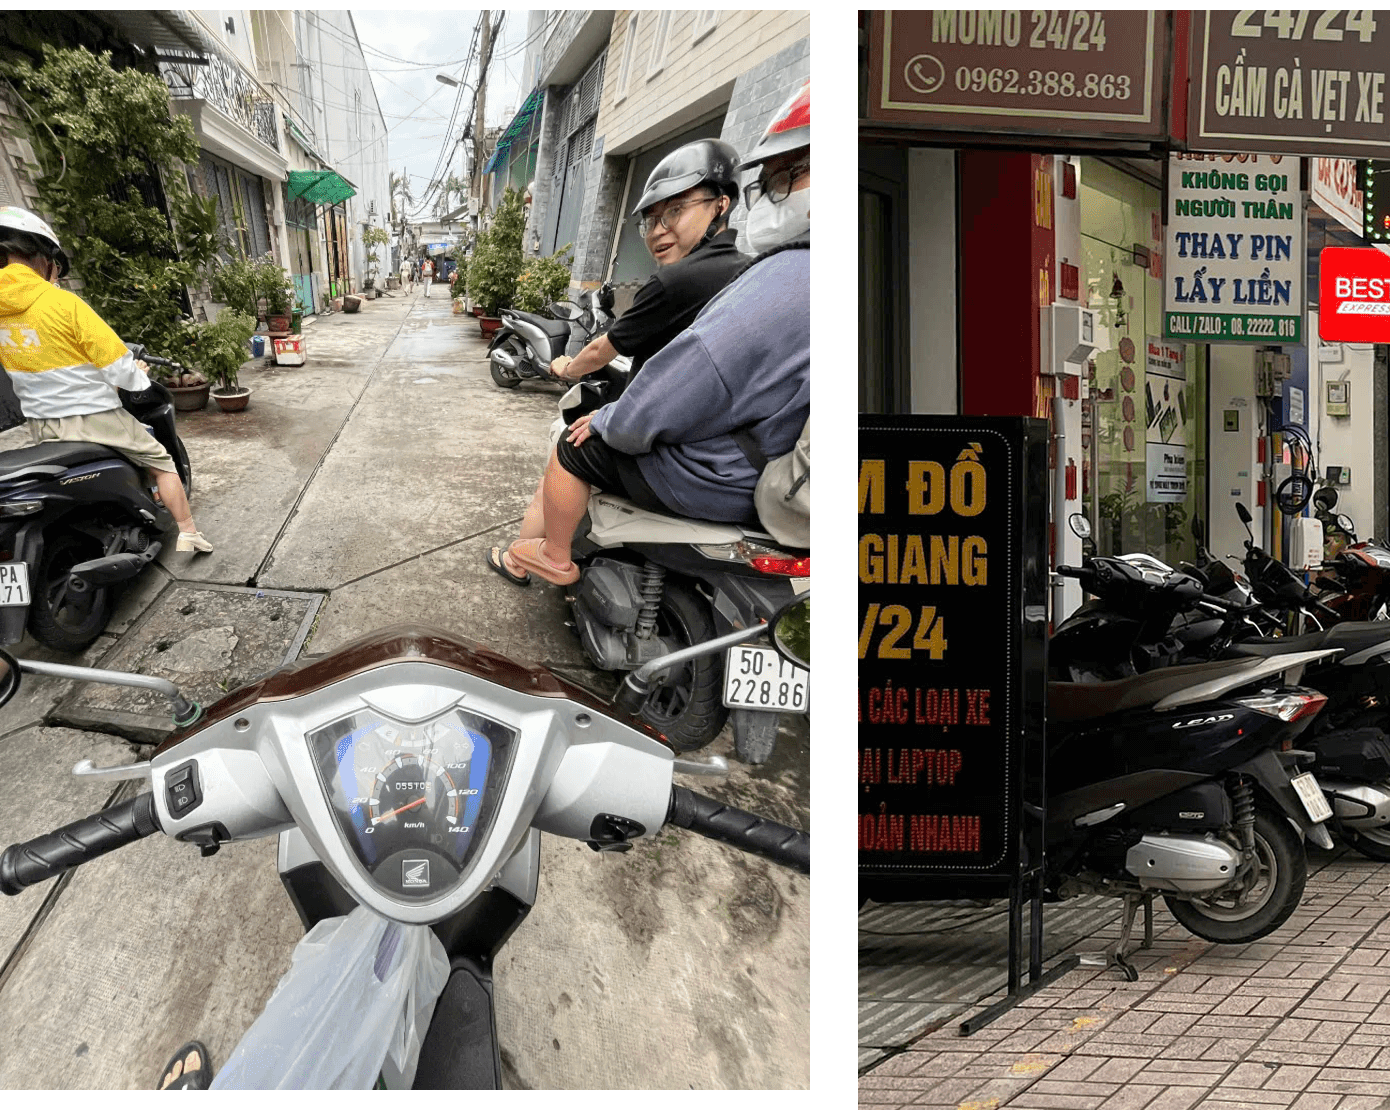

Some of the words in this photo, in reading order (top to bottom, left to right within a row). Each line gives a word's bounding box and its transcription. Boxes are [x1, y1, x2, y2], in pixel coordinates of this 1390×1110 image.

[1029, 9, 1107, 51] 24/24
[955, 66, 1132, 100] 0962.388.863
[1215, 47, 1268, 118] CẦM
[1273, 57, 1303, 119] CÀ
[1311, 69, 1351, 133] VẸT
[1354, 72, 1386, 124] XE
[1181, 169, 1249, 191] KHÔNG
[1255, 173, 1288, 195] GỌI
[1175, 196, 1236, 218] NGƯỜI
[1242, 199, 1293, 220] THÂN
[1175, 231, 1243, 260] THAY
[1250, 234, 1292, 262] PIN
[1174, 266, 1226, 304] LẤY
[1233, 267, 1292, 306] LIỀN
[60, 471, 101, 486] VISION
[905, 442, 987, 517] ĐỒ
[858, 533, 988, 586] GIANG
[729, 678, 804, 708] 228.86
[869, 679, 909, 724] CÁC
[915, 688, 959, 733] LOẠI
[966, 689, 991, 725] XE
[1172, 714, 1234, 729] LEAD
[858, 748, 881, 792] ẠI
[887, 748, 962, 785] LAPTOP
[404, 821, 425, 829] km/h
[858, 801, 905, 851] OẢN
[911, 814, 981, 852] NHANH
